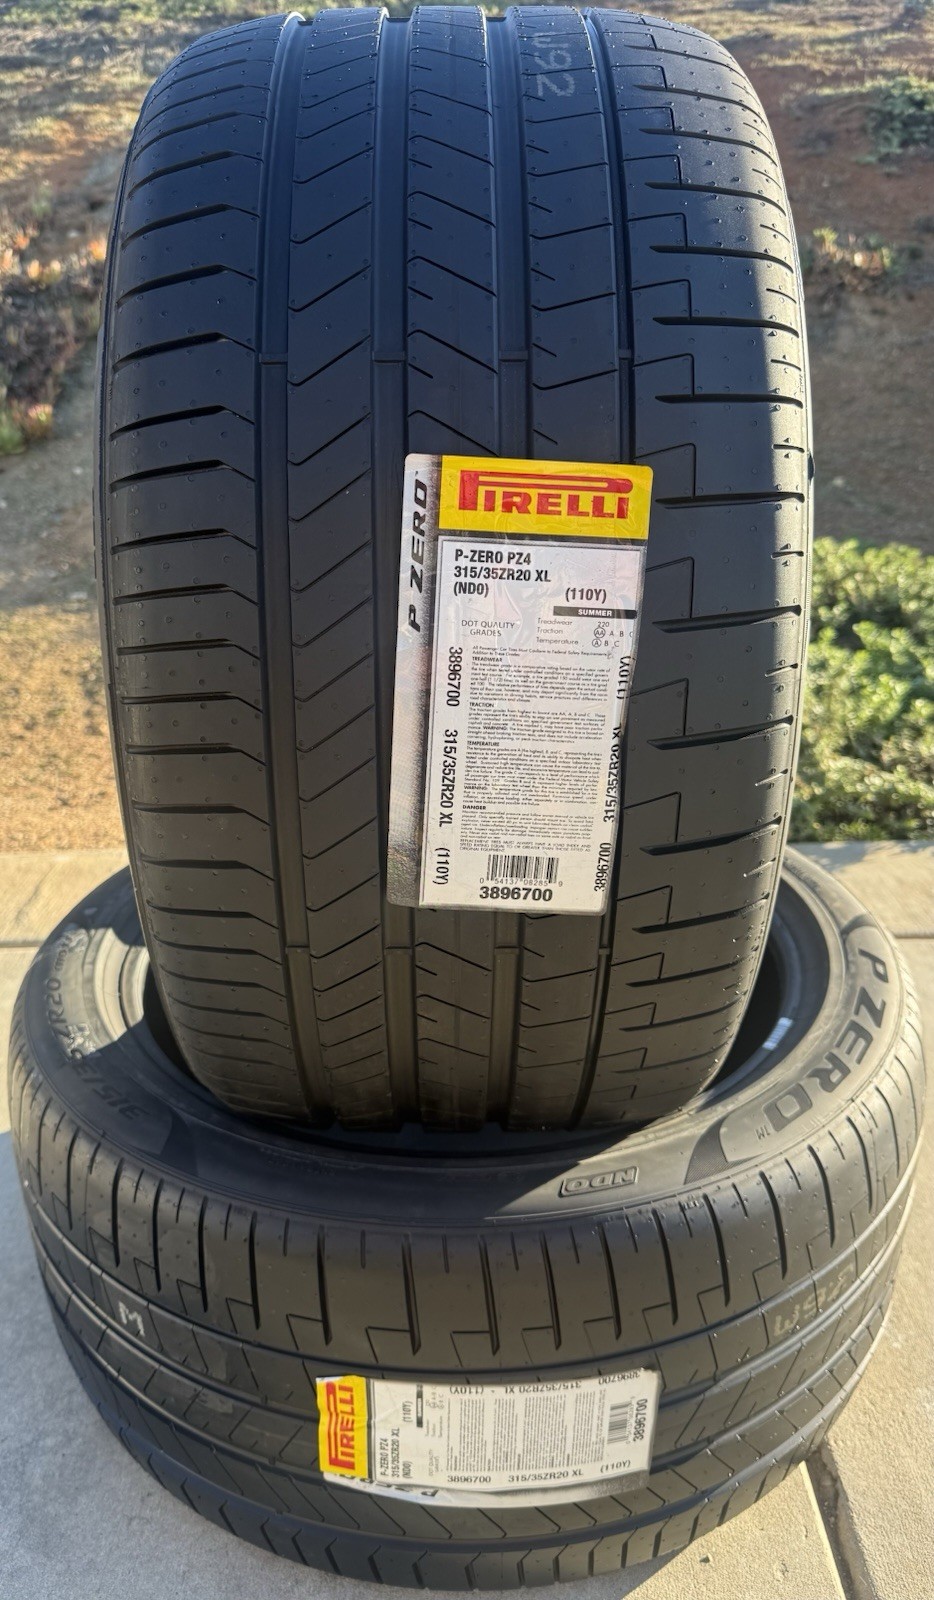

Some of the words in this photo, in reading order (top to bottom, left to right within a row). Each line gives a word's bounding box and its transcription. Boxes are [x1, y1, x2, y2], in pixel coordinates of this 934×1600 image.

[458, 470, 634, 519] PIRELLI
[409, 478, 428, 594] ZERO
[454, 549, 503, 565] P-ZERO
[507, 550, 531, 566] PZ4
[454, 565, 532, 582] 315/35ZR20
[534, 568, 551, 583] XL
[565, 586, 607, 604] (110Y)
[408, 604, 421, 633] P
[480, 620, 515, 629] QUALITY
[537, 618, 573, 626] Treadwear
[578, 608, 612, 617] SUMMER
[470, 628, 502, 637] GRADES
[536, 637, 579, 646] Temperature
[446, 646, 463, 707] 3896700
[440, 729, 458, 809] 315/35ZR20
[439, 812, 453, 828] XL
[433, 847, 451, 886] (110Y)
[594, 842, 612, 892] 3896700
[479, 886, 553, 902] 3896700
[858, 948, 889, 984] P
[761, 986, 887, 1132] ZERO
[326, 1381, 355, 1470] PIRELLI
[633, 1398, 648, 1442] 3896700
[447, 1475, 491, 1483] 3896700
[508, 1470, 569, 1482] 315/35ZR20
[600, 1460, 631, 1474] (110Y)
